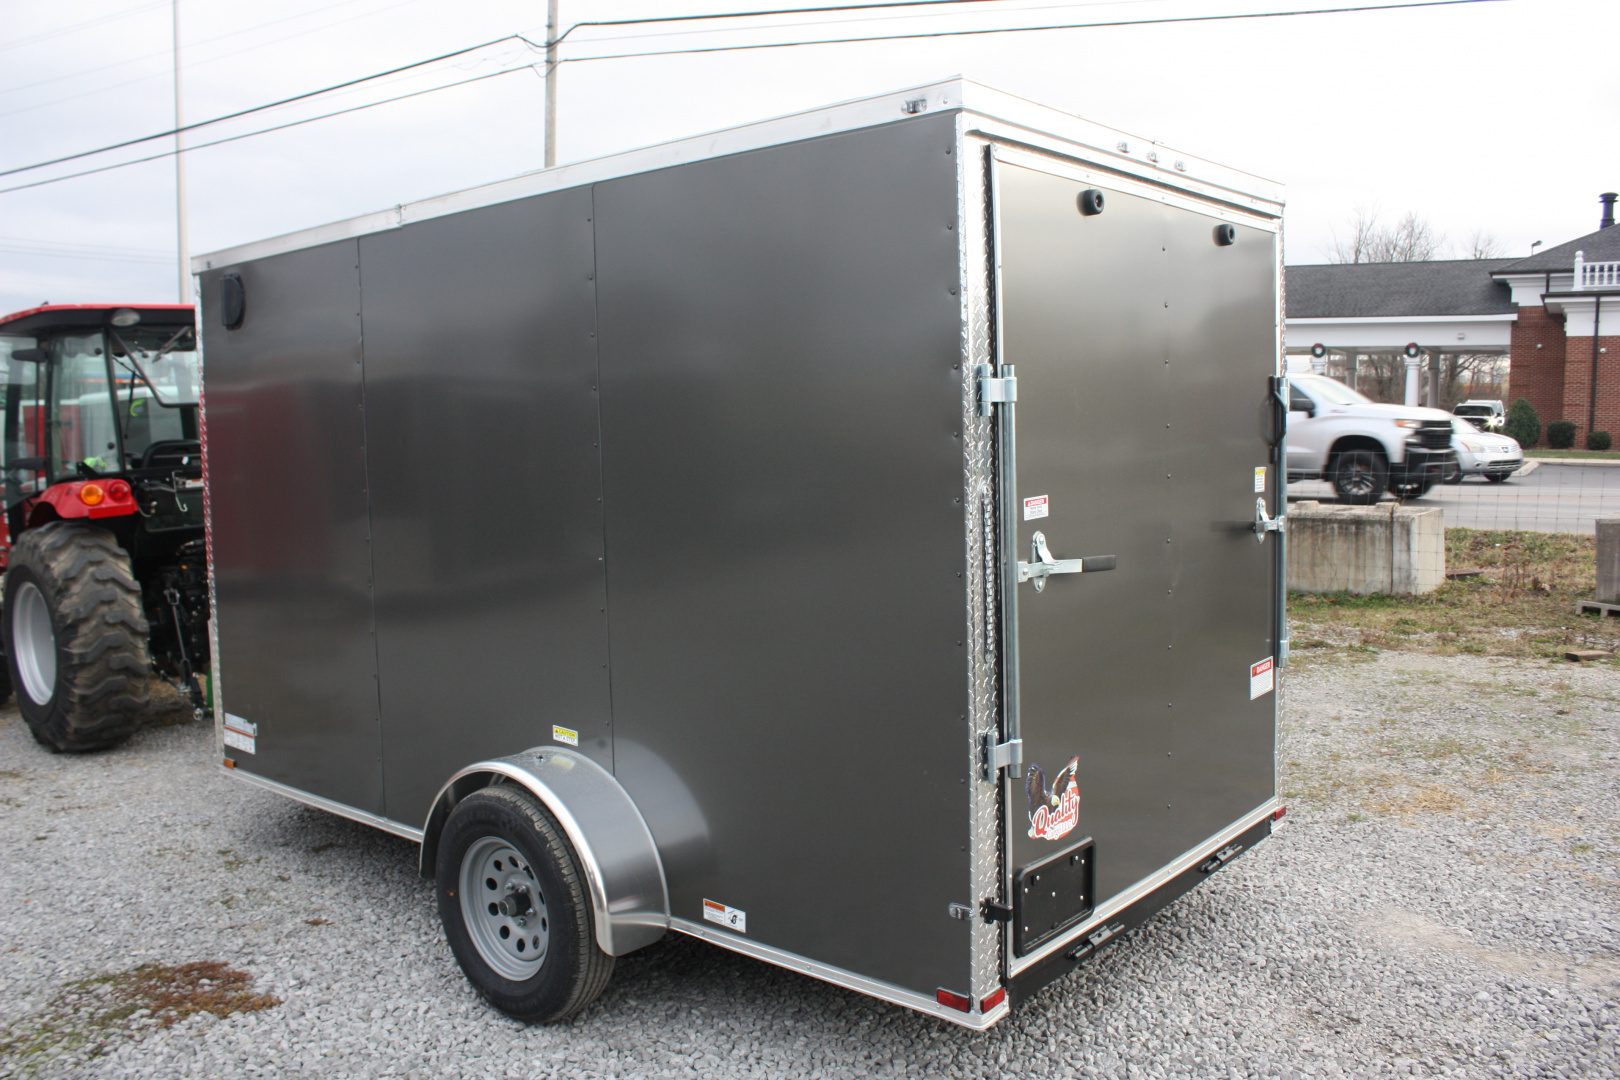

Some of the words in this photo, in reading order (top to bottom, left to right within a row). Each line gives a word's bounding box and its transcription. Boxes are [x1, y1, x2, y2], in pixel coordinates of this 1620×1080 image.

[1257, 661, 1271, 673] DANGER
[558, 729, 576, 737] CAUTION
[1033, 789, 1080, 836] Quality
